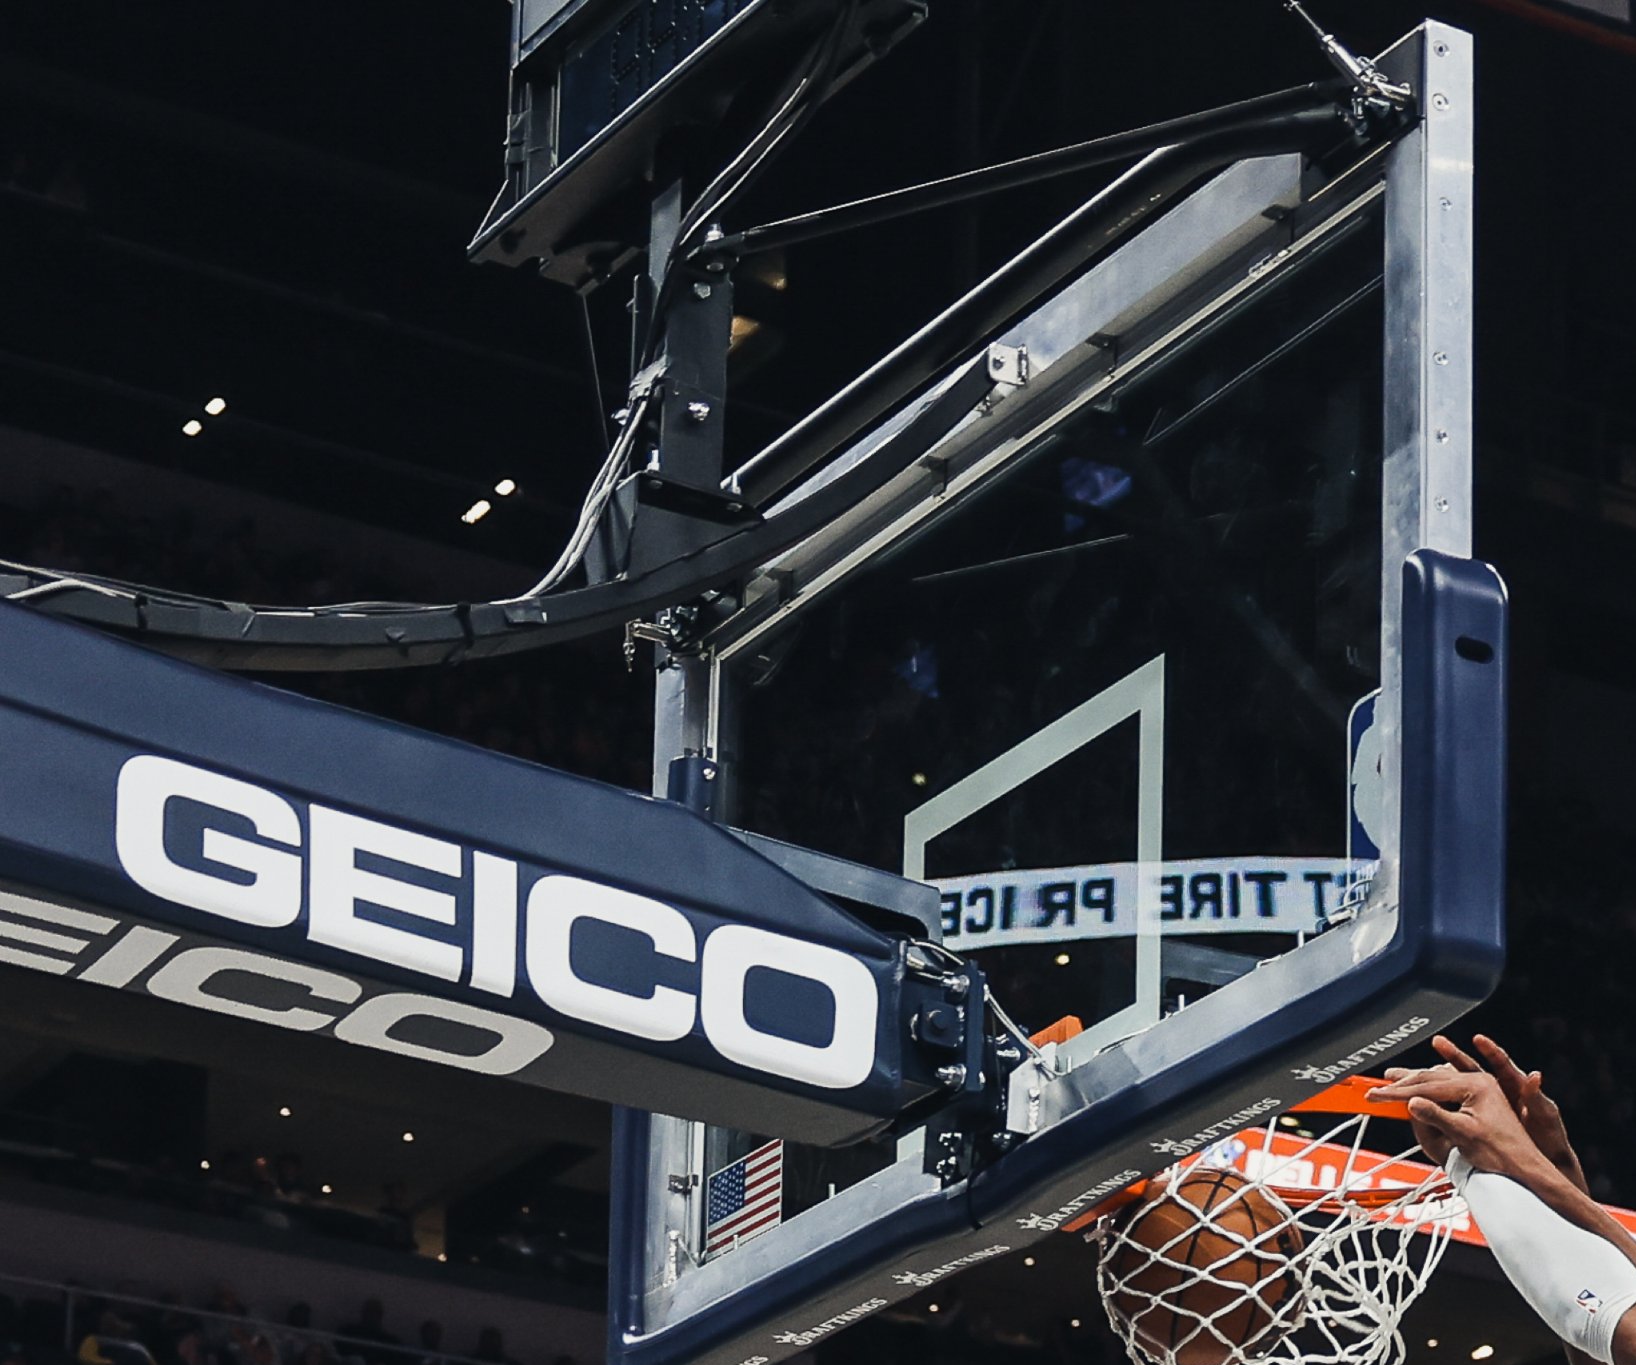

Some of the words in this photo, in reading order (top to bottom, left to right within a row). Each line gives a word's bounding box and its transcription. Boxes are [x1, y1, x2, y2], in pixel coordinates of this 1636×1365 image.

[115, 754, 878, 1089] GEICO
[1312, 1015, 1430, 1084] DRAFTKINGS
[1169, 1097, 1281, 1157] DRAFTKINGS
[1036, 1169, 1142, 1231] DRAFTKINGS
[792, 1297, 887, 1347] DRAFTKINGS
